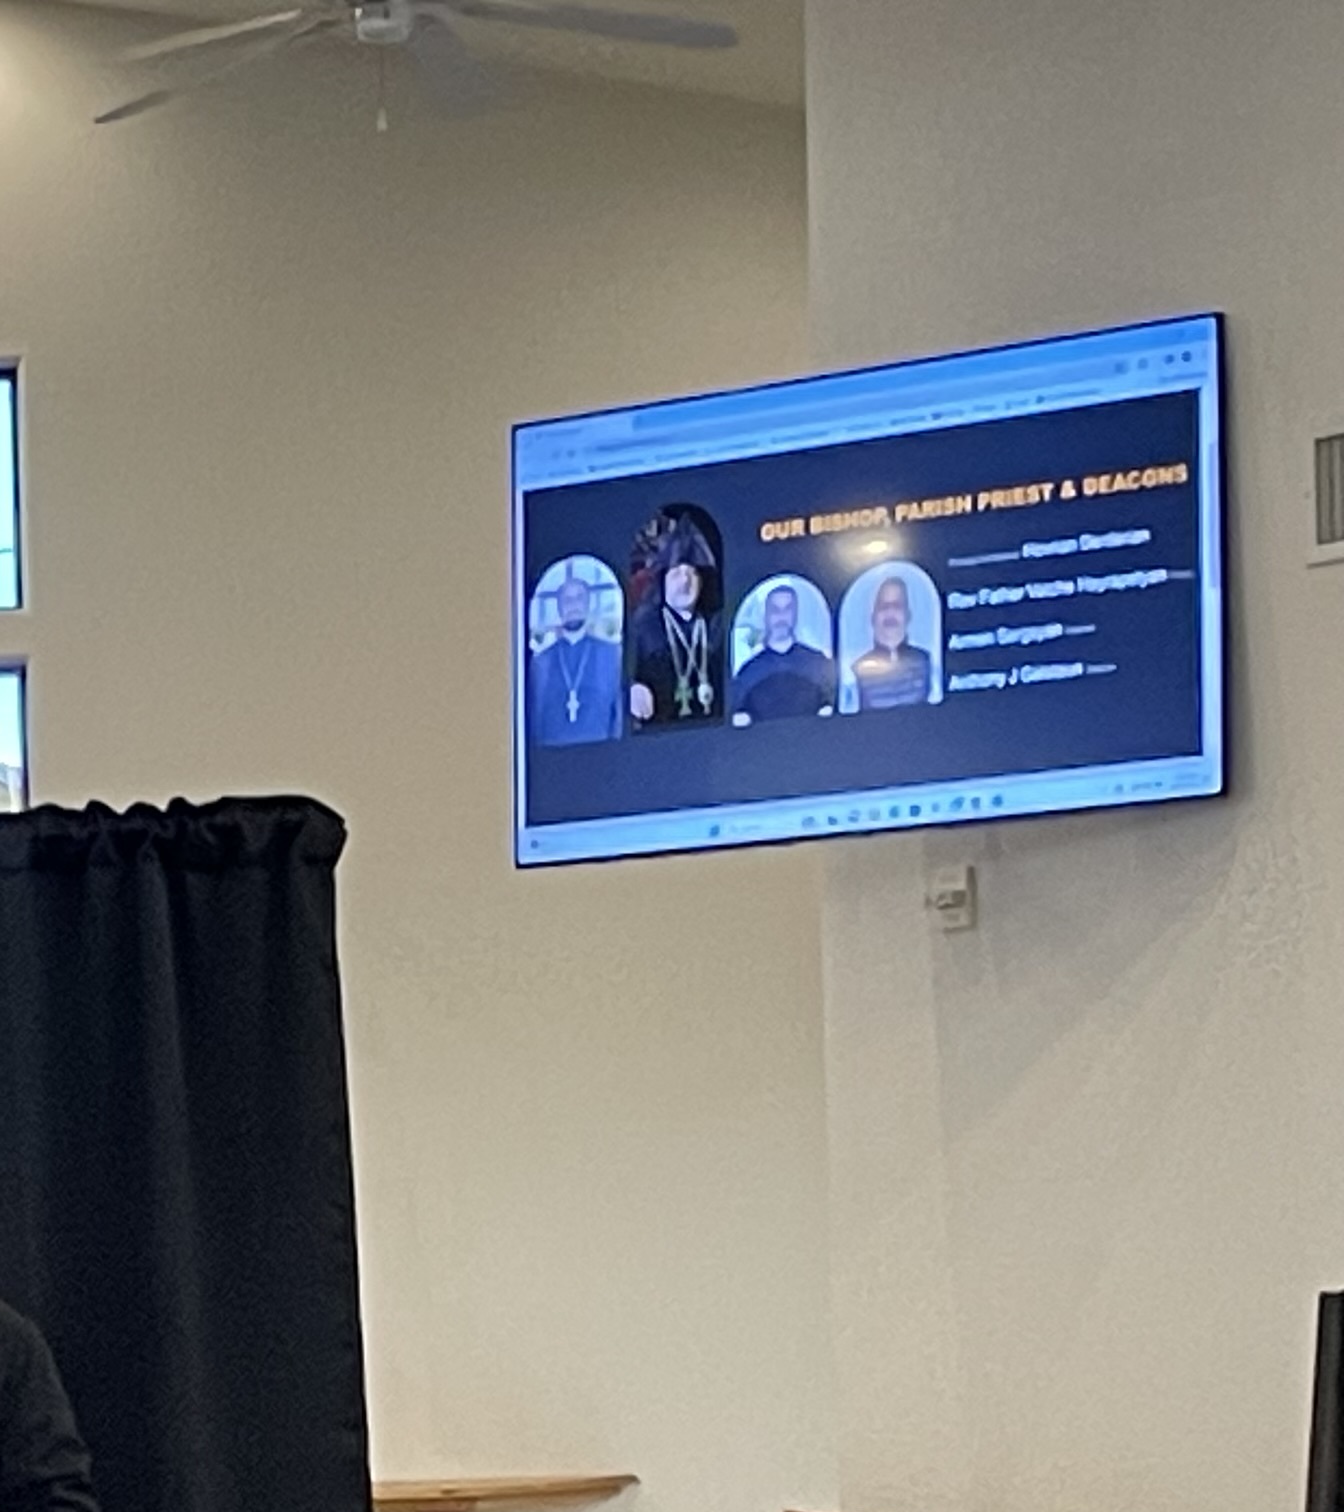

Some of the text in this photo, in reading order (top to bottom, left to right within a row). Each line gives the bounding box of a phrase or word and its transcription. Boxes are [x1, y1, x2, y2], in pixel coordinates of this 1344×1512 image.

[760, 463, 1189, 542] OUR BISHOP, PARISH PRIEST & DEACONS
